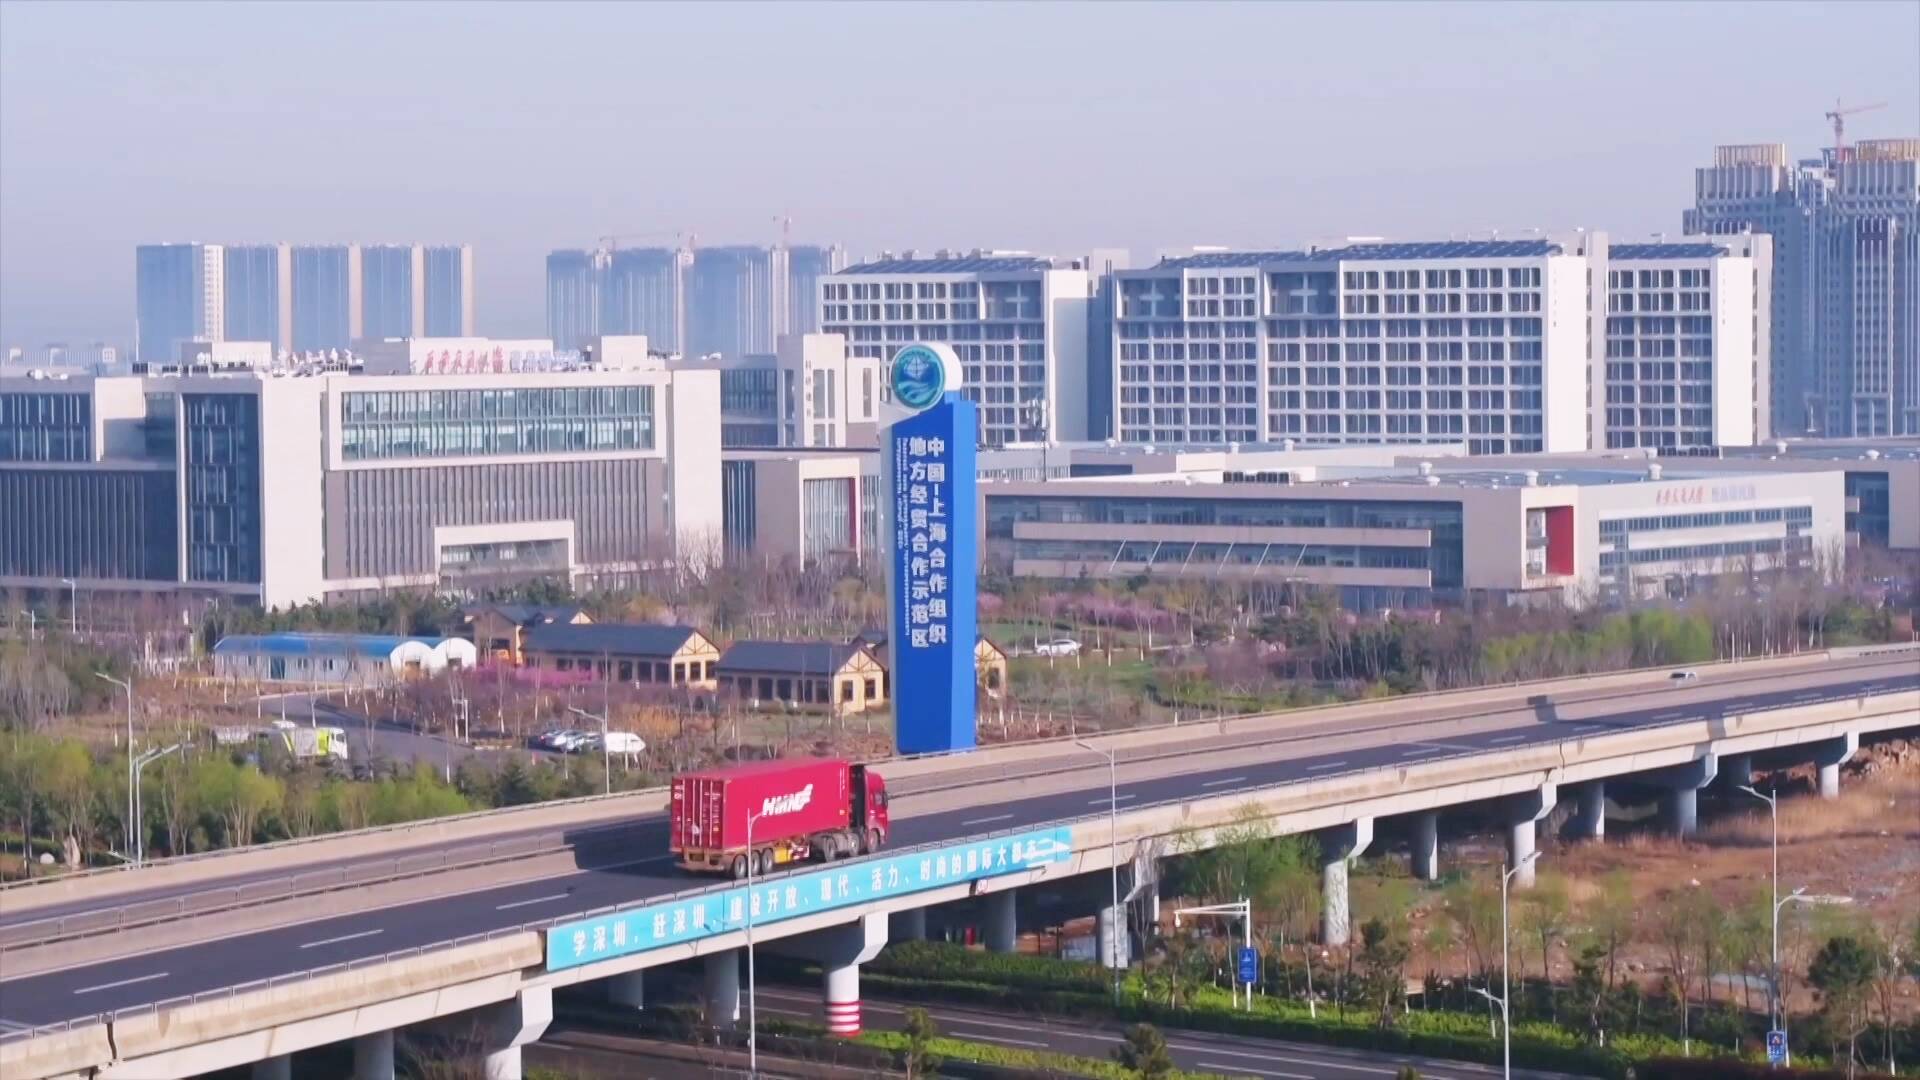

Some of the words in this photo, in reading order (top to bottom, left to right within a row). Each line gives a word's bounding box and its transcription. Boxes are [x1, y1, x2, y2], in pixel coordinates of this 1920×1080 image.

[909, 437, 929, 647] 地方经贸合作示范区
